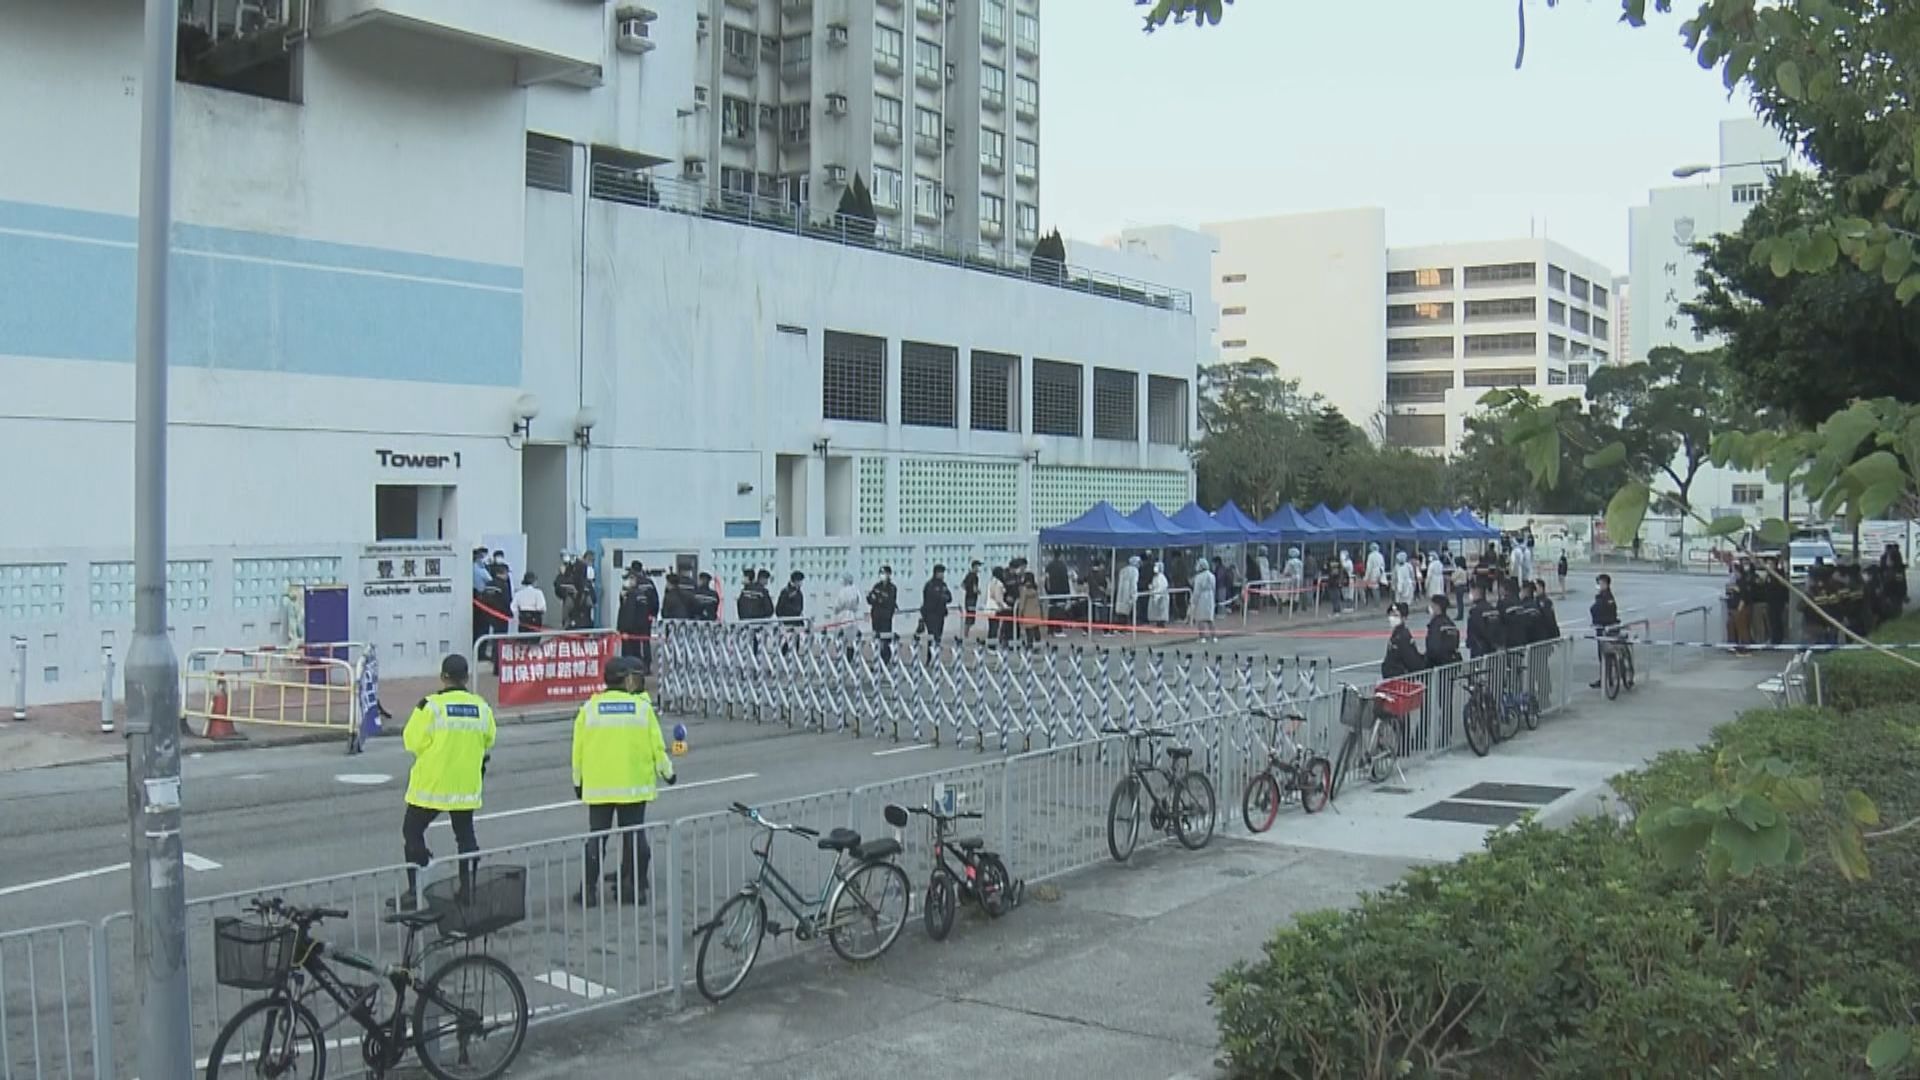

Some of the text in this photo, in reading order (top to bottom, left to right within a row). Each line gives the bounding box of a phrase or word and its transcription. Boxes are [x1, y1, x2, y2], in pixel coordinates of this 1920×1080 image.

[376, 449, 461, 469] Tower 1
[364, 583, 453, 598] Goodview Garden
